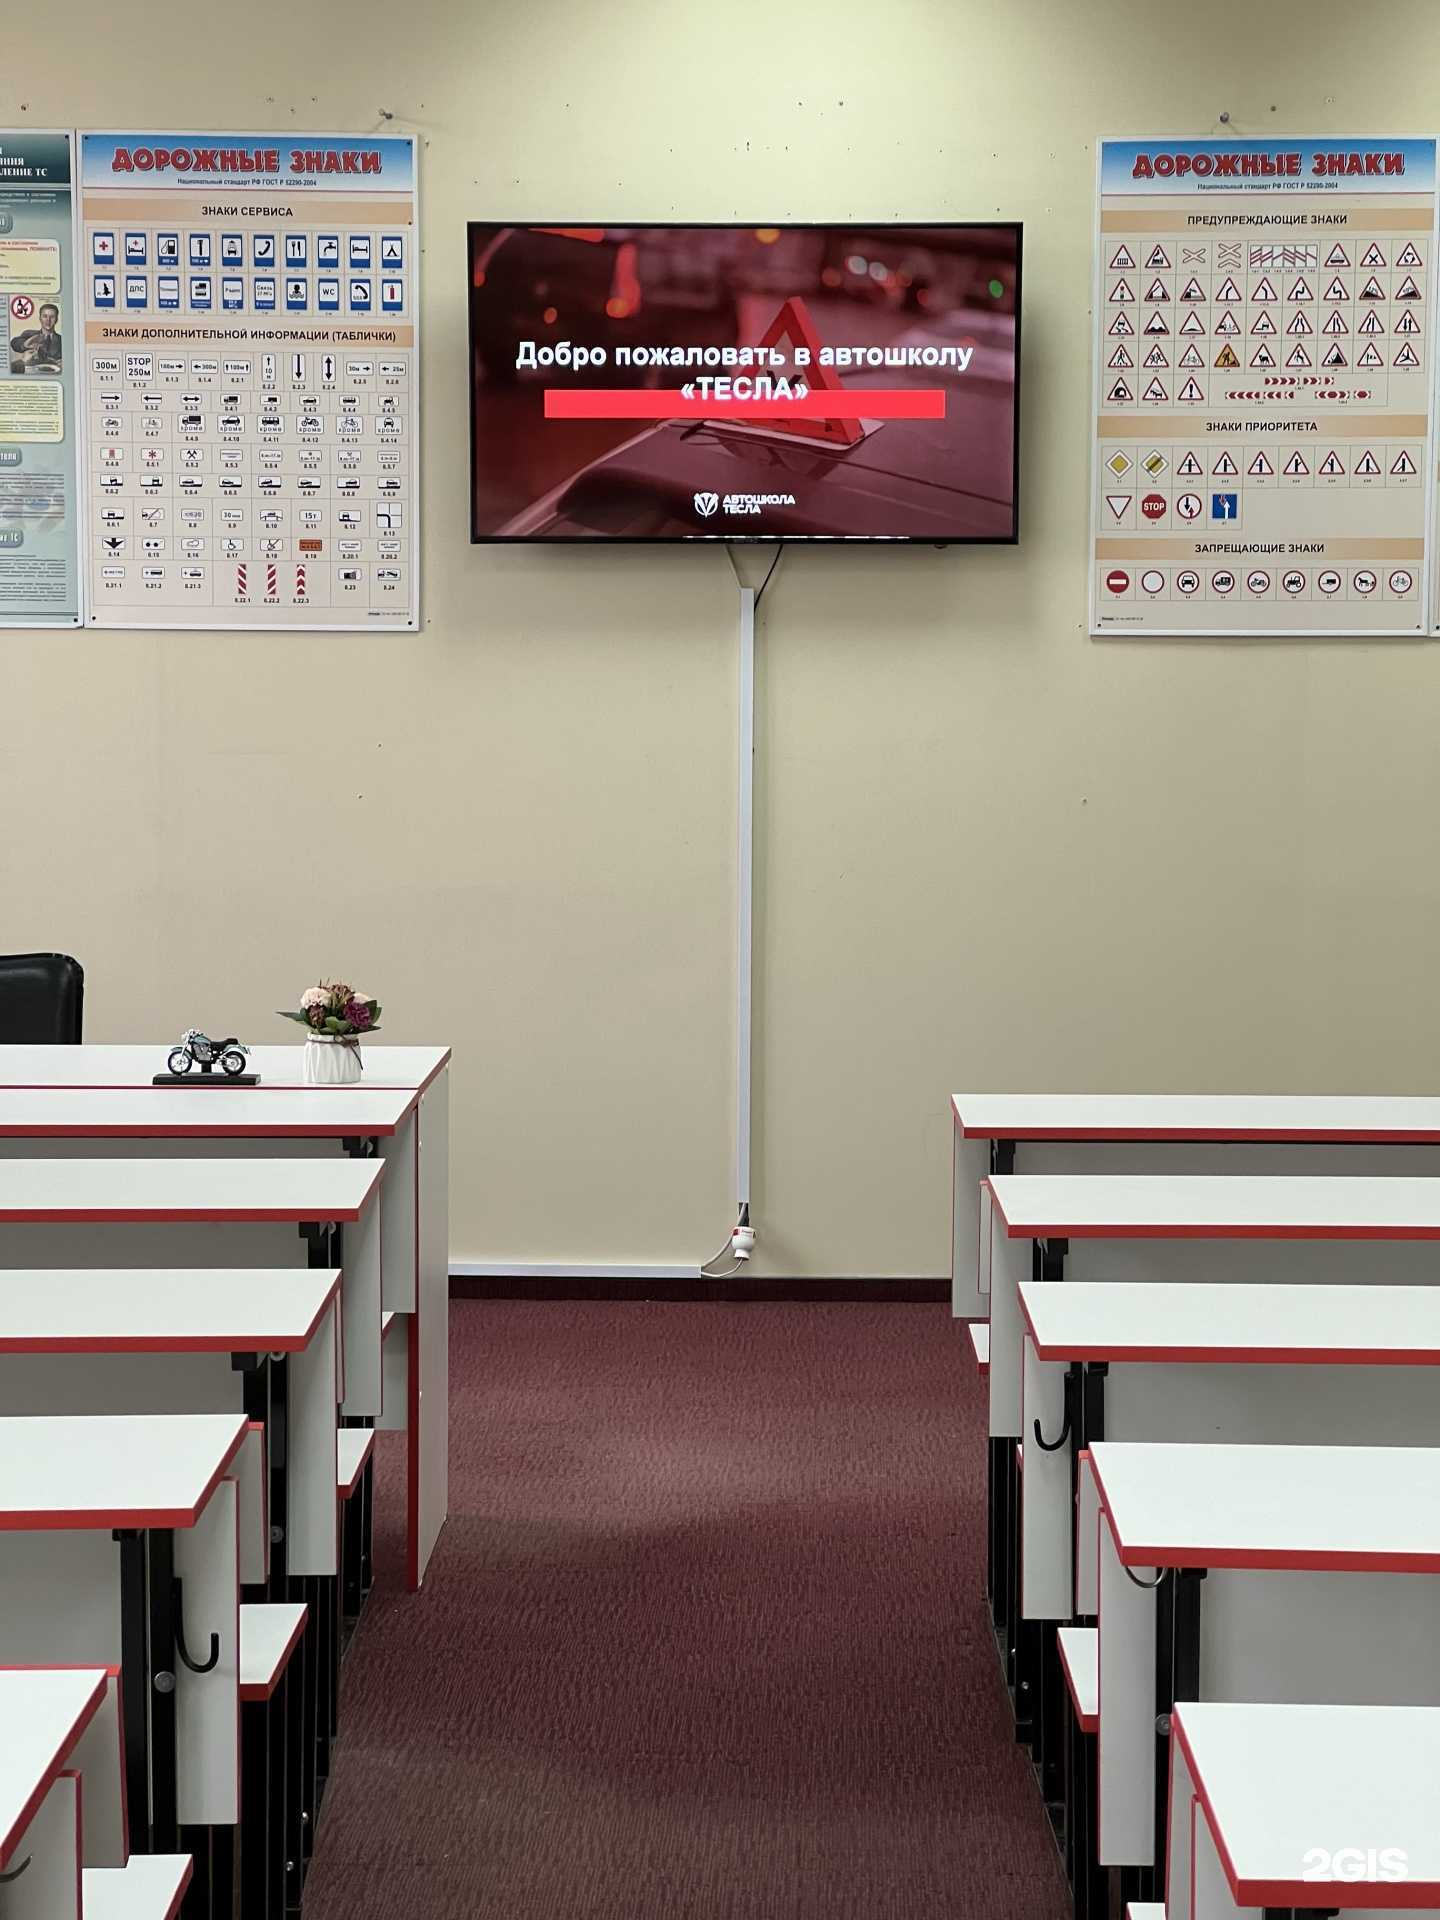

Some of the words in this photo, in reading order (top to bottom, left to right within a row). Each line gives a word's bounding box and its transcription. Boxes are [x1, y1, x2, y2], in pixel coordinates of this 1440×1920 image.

[111, 147, 280, 172] ДОРОЖНЫЕ
[289, 149, 382, 174] ЗНАКИ
[1132, 152, 1302, 178] ДОРОЖНЫЕ
[1312, 152, 1405, 177] ЗНАКИ
[35, 168, 48, 176] ТС
[202, 206, 238, 216] ЗНАКИ
[241, 207, 294, 216] СЕРВИСА
[1188, 215, 1308, 226] ПРЕДУПРЕЖДАЮЩИЕ
[1310, 214, 1348, 224] ЗНАКИ
[102, 328, 138, 337] ЗНАКИ
[141, 328, 248, 340] ДОПОЛНИТЕЛЬНОЙ
[250, 330, 329, 342] ИНФОРМАЦИИ
[332, 331, 396, 342] (ТАБЛИЧКИ)
[516, 341, 607, 370] Добро
[615, 346, 786, 366] пожаловать
[794, 347, 811, 366] в
[819, 347, 974, 371] автошколу
[128, 358, 151, 366] STOP
[680, 376, 809, 400] «ТЕСЛА»
[1206, 422, 1242, 432] ЗНАКИ
[1245, 422, 1318, 432] ПРИОРИТЕТА
[722, 494, 796, 504] АВТОШКОЛА
[722, 504, 761, 514] ТЕСЛА
[1143, 502, 1164, 511] STOP
[1195, 544, 1285, 554] ЗАПРЕЩАЮЩИЕ
[1288, 544, 1324, 553] ЗНАКИ
